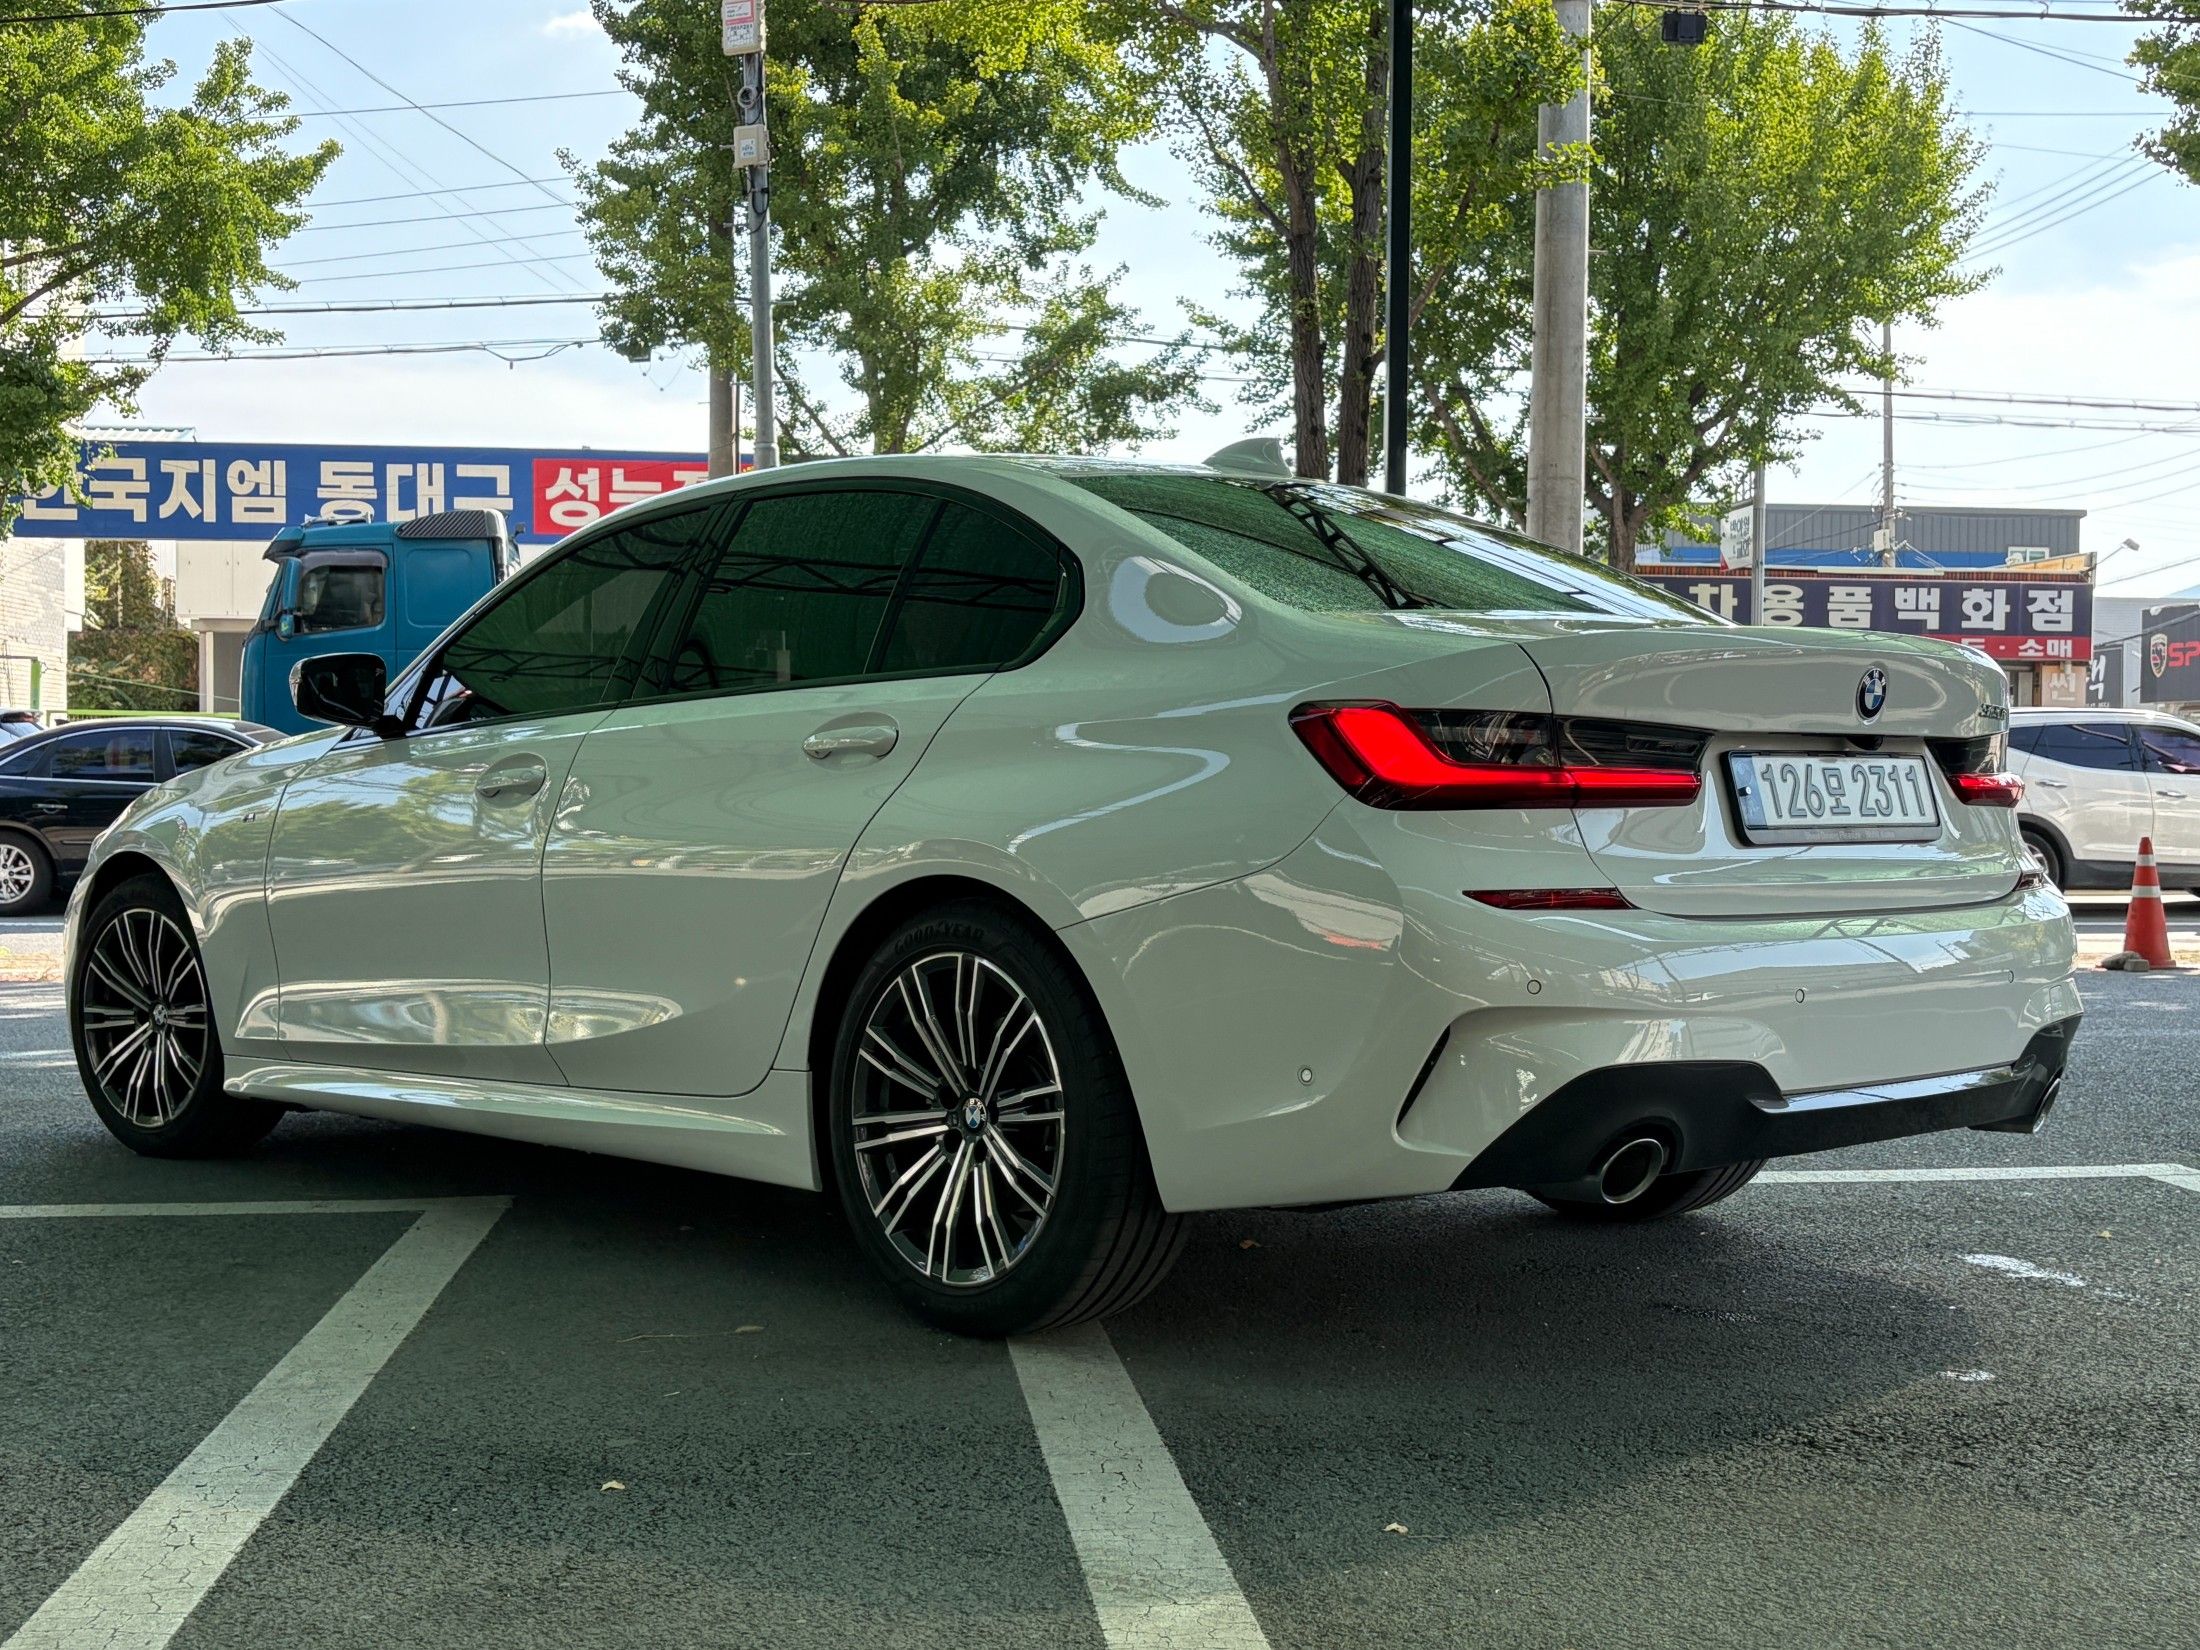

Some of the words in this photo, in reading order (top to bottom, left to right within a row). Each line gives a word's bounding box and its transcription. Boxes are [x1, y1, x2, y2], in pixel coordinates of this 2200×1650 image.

[21, 458, 287, 523] 한국지엠
[317, 461, 513, 524] 동대구
[545, 467, 709, 527] 성능
[1658, 583, 2074, 632] 차용품백화점
